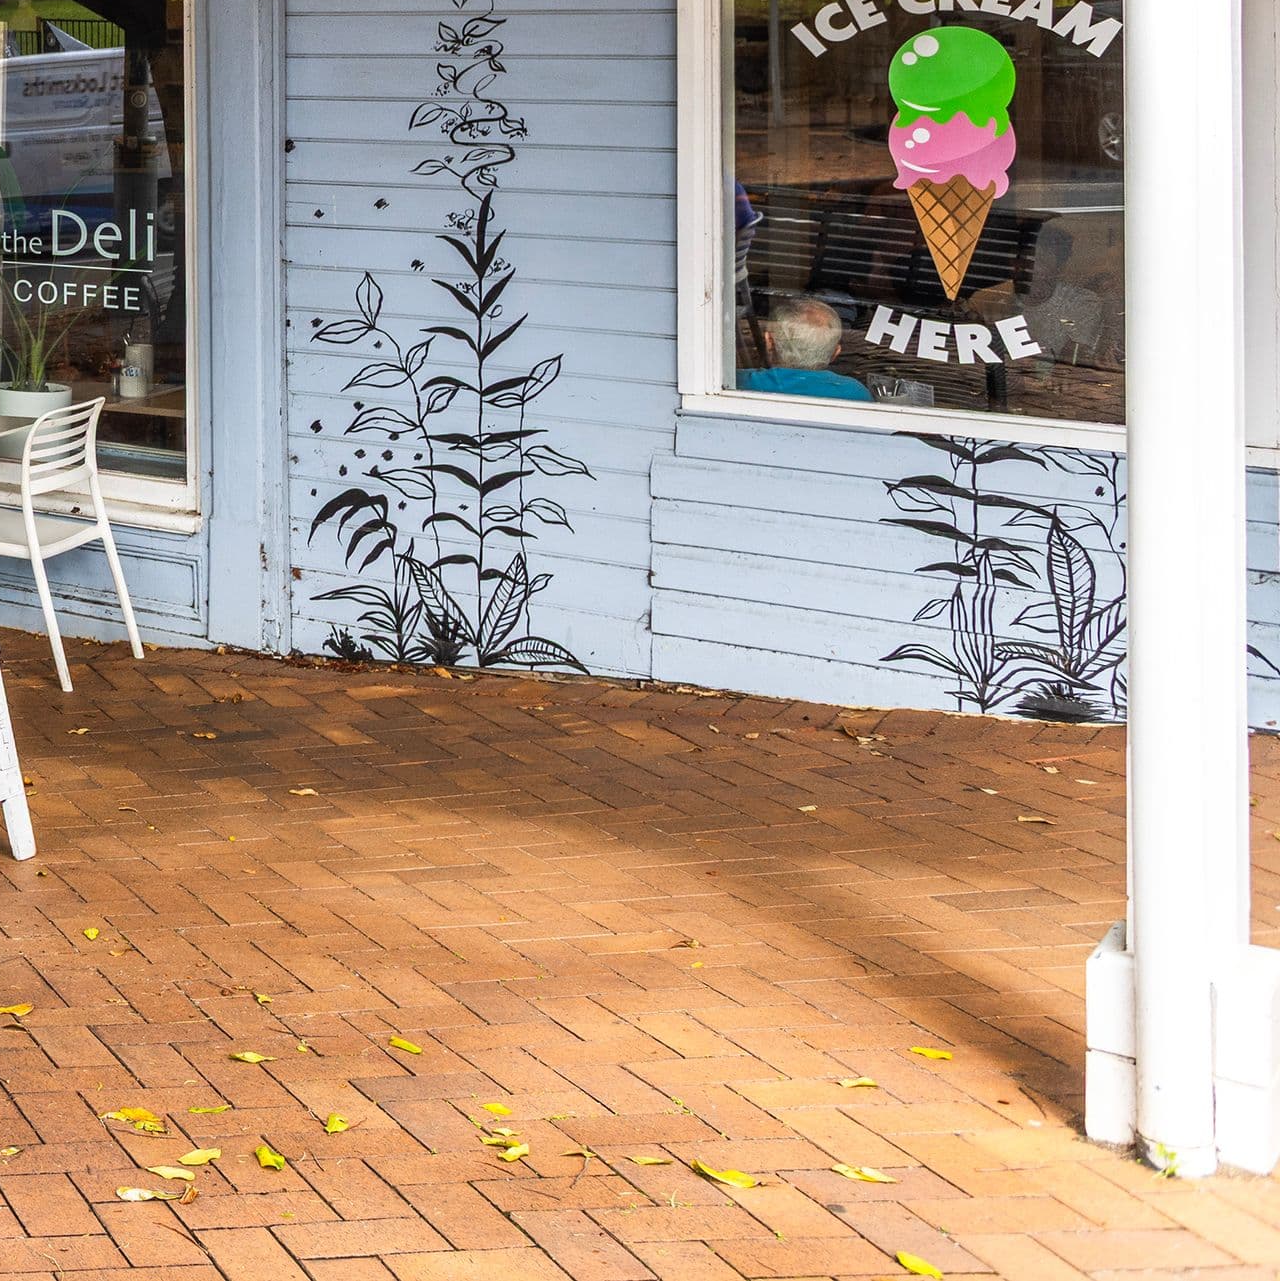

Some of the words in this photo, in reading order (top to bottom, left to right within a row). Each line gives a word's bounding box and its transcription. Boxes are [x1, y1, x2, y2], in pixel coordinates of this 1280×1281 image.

[1, 230, 43, 255] the
[52, 208, 156, 262] Deli
[14, 279, 142, 312] COFFEE
[864, 305, 1042, 364] HERE
